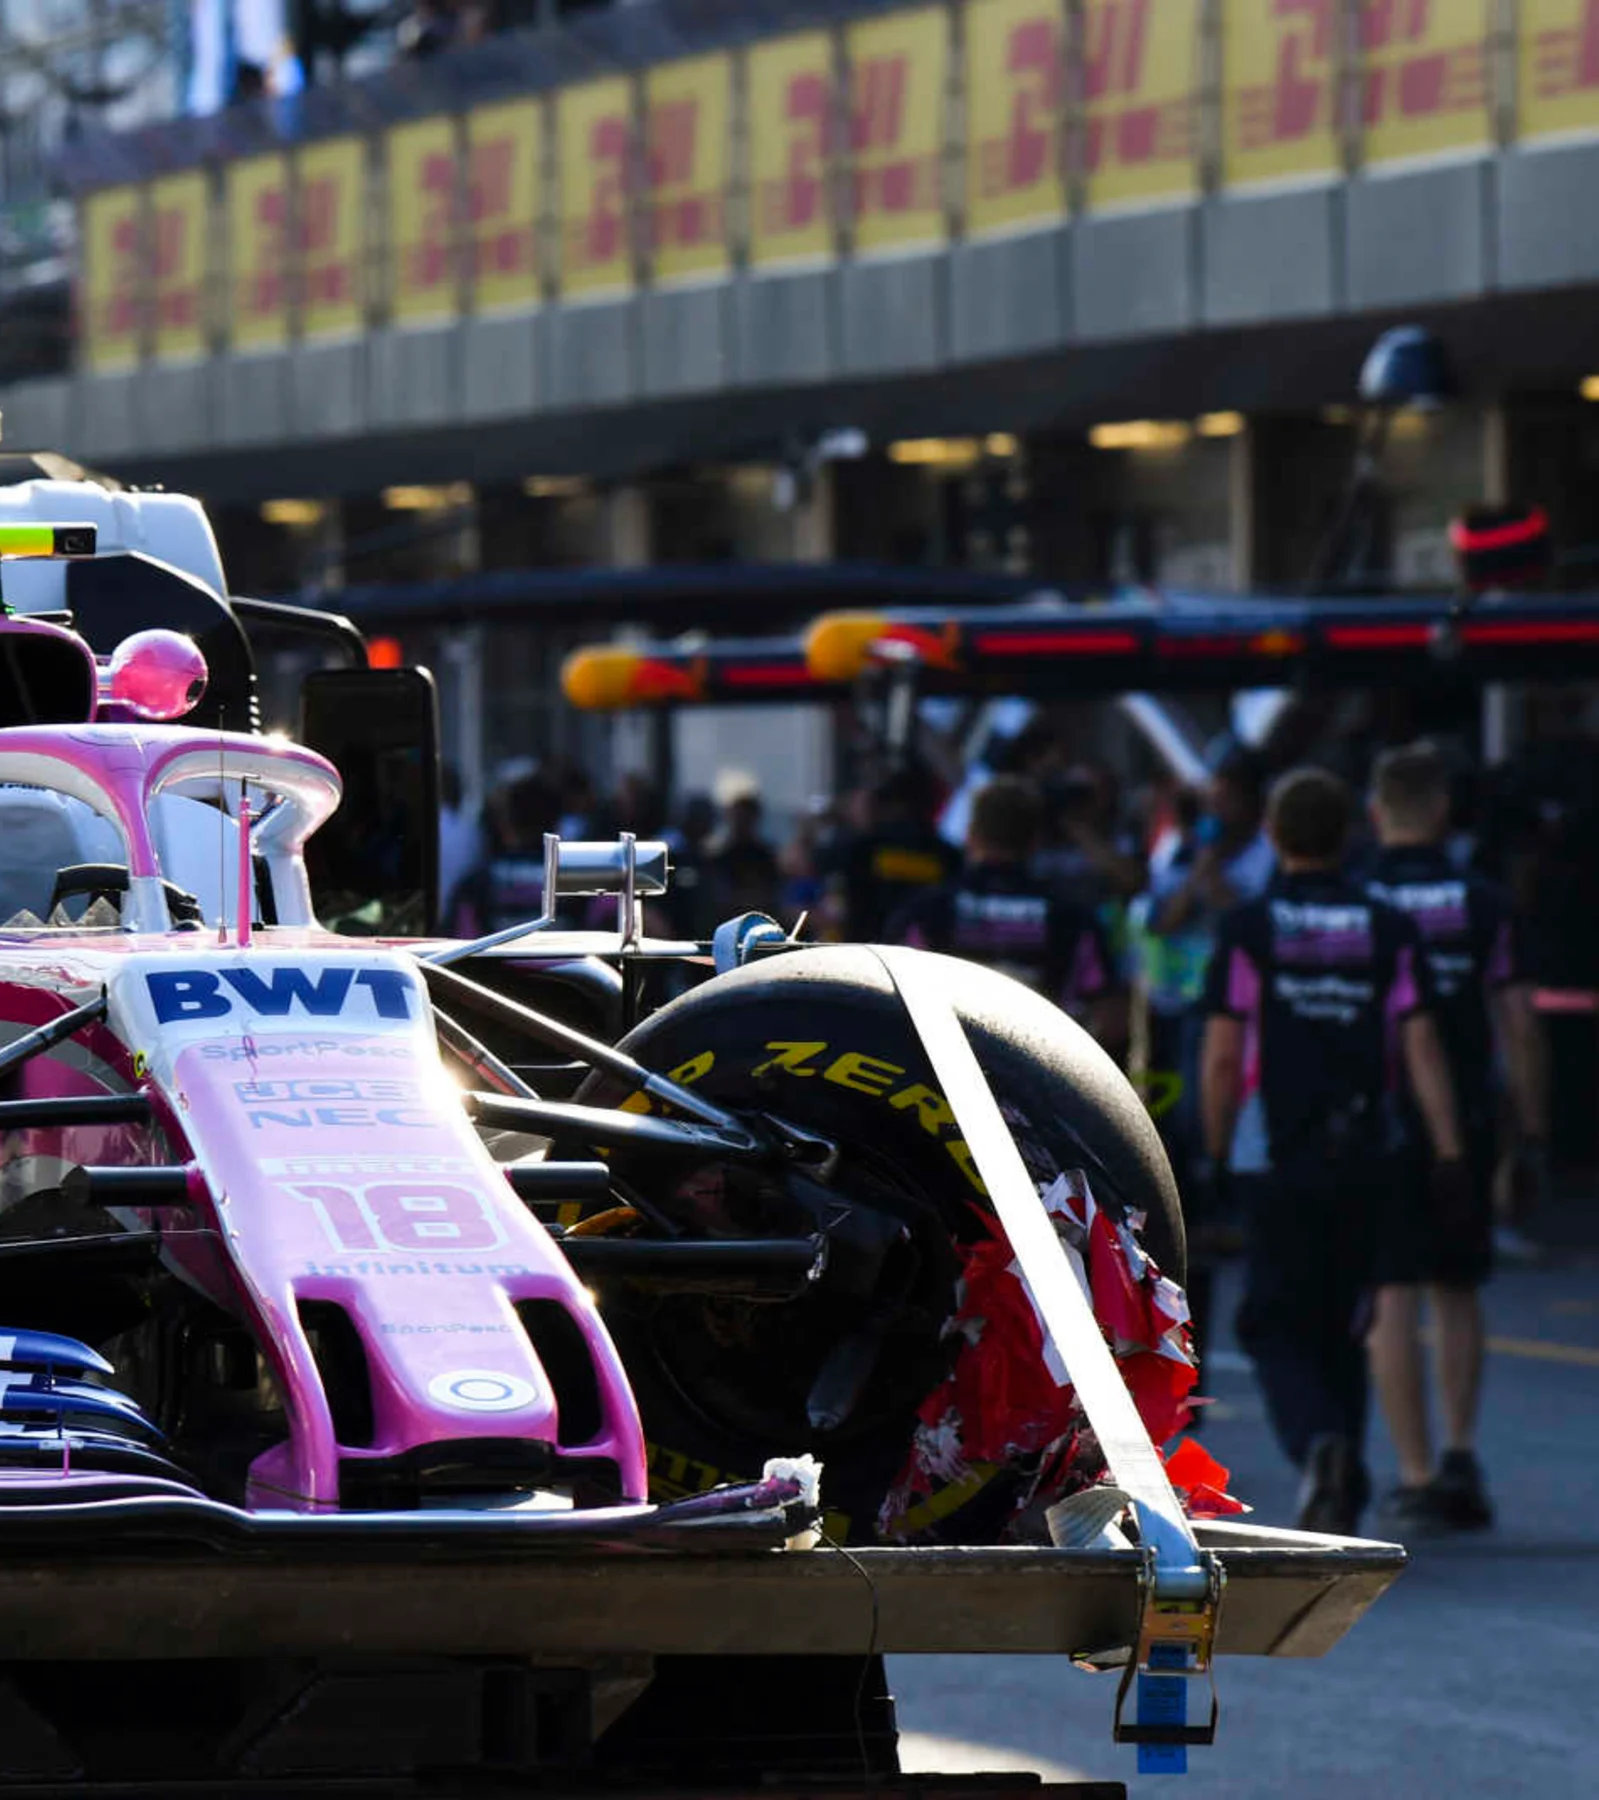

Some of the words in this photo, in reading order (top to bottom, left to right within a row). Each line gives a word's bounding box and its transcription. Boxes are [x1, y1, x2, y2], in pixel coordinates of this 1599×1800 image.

[146, 967, 414, 1025] BWT
[246, 1108, 437, 1129] NEC
[281, 1180, 509, 1254] 18
